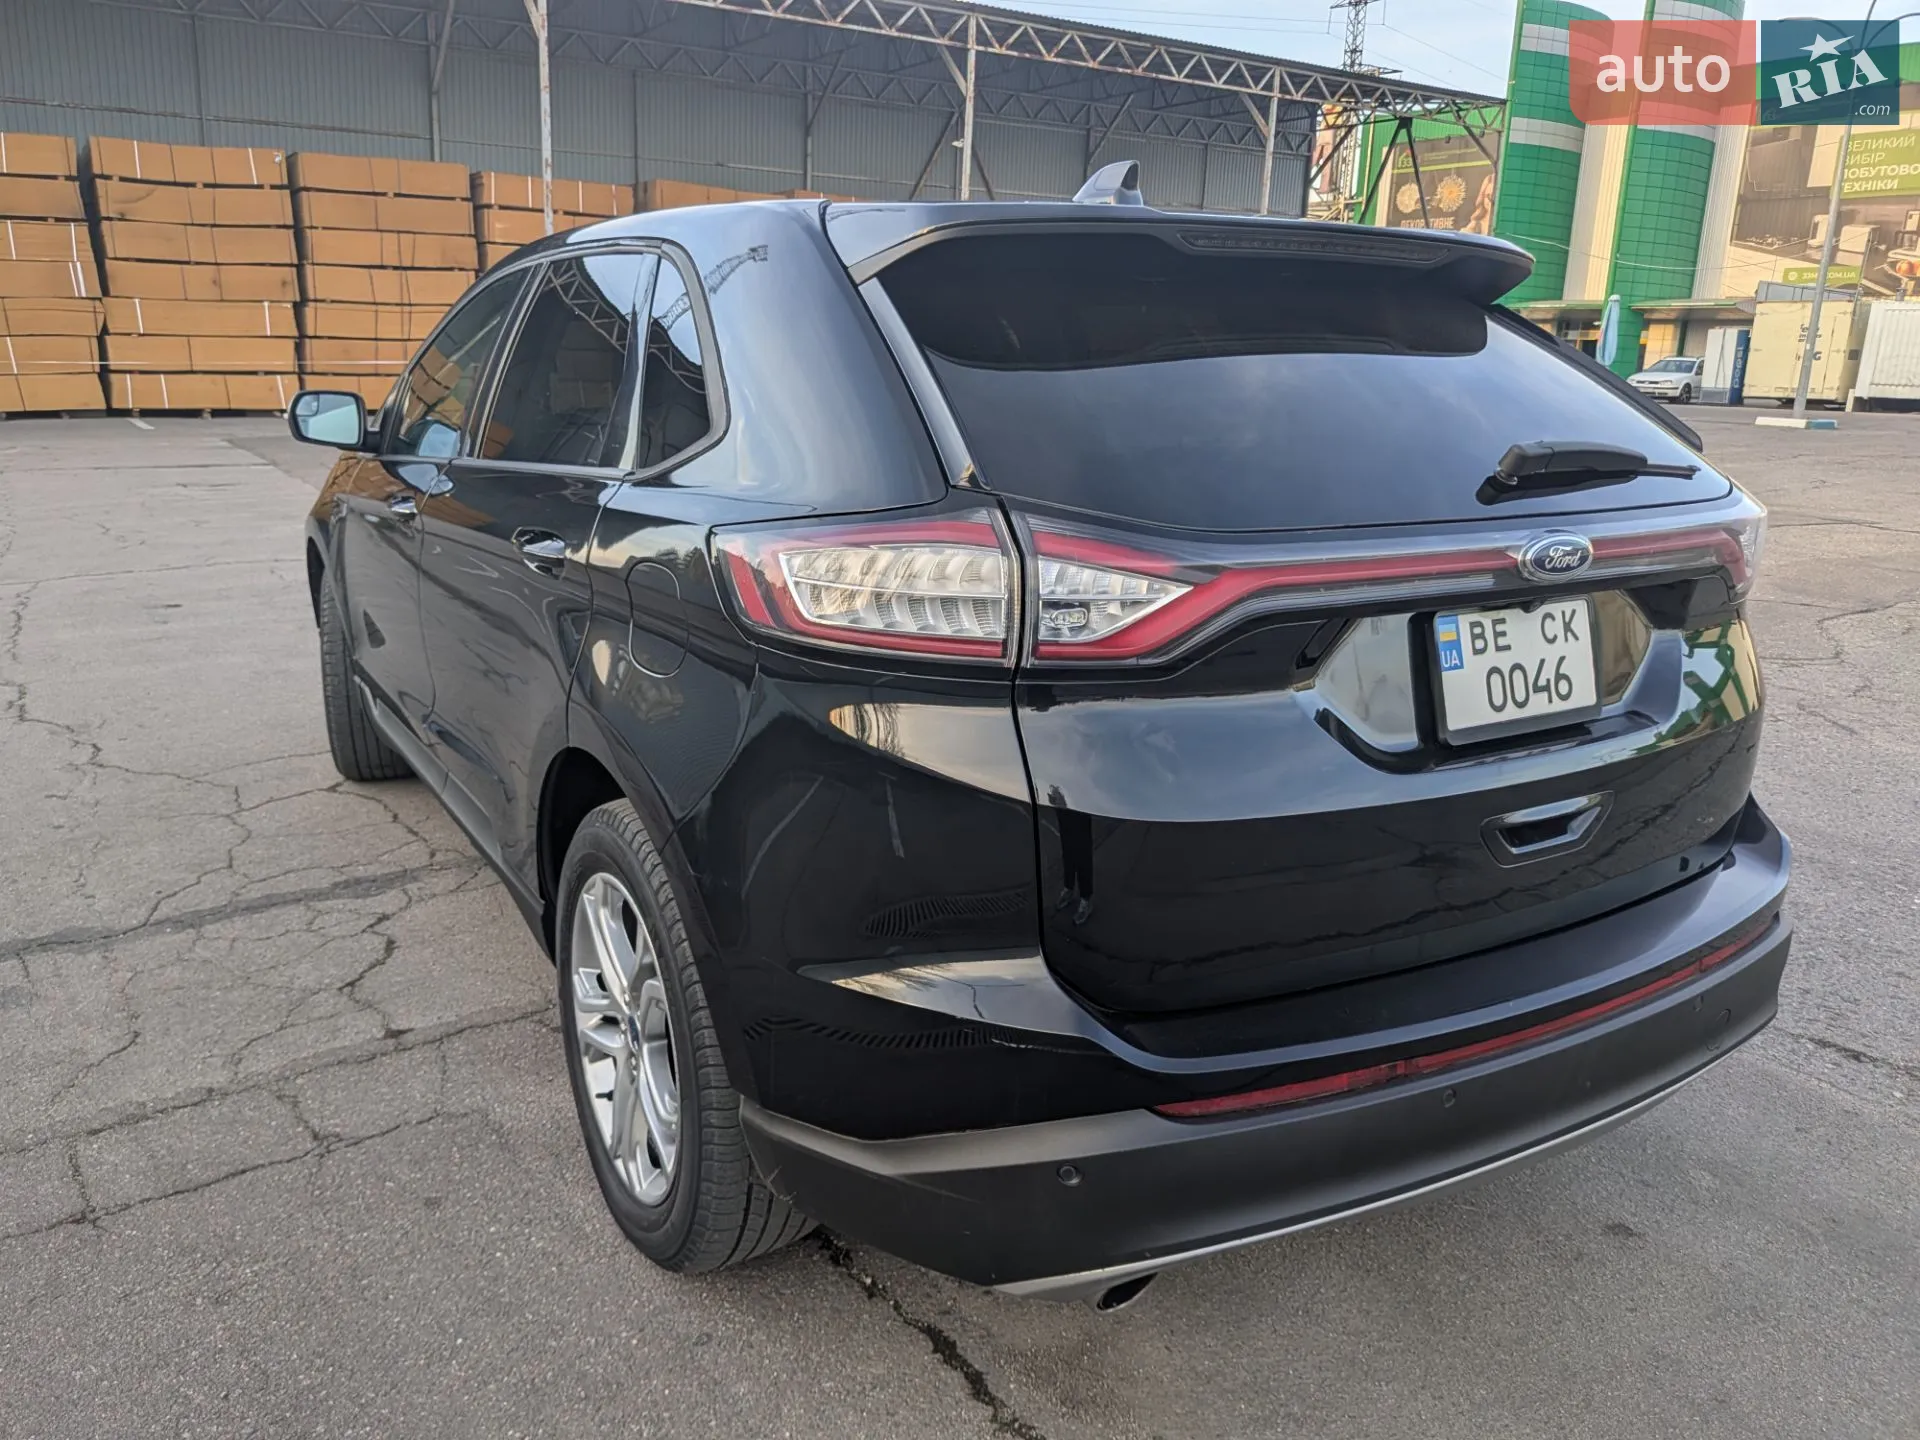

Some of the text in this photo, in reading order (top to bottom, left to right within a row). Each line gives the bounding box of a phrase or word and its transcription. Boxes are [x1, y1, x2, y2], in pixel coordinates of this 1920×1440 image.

[1842, 178, 1899, 192] ЕХНІКИ
[1544, 545, 1581, 569] Ford
[1469, 608, 1580, 656] BE CK
[1441, 650, 1461, 668] UA
[1485, 655, 1573, 713] 0046
